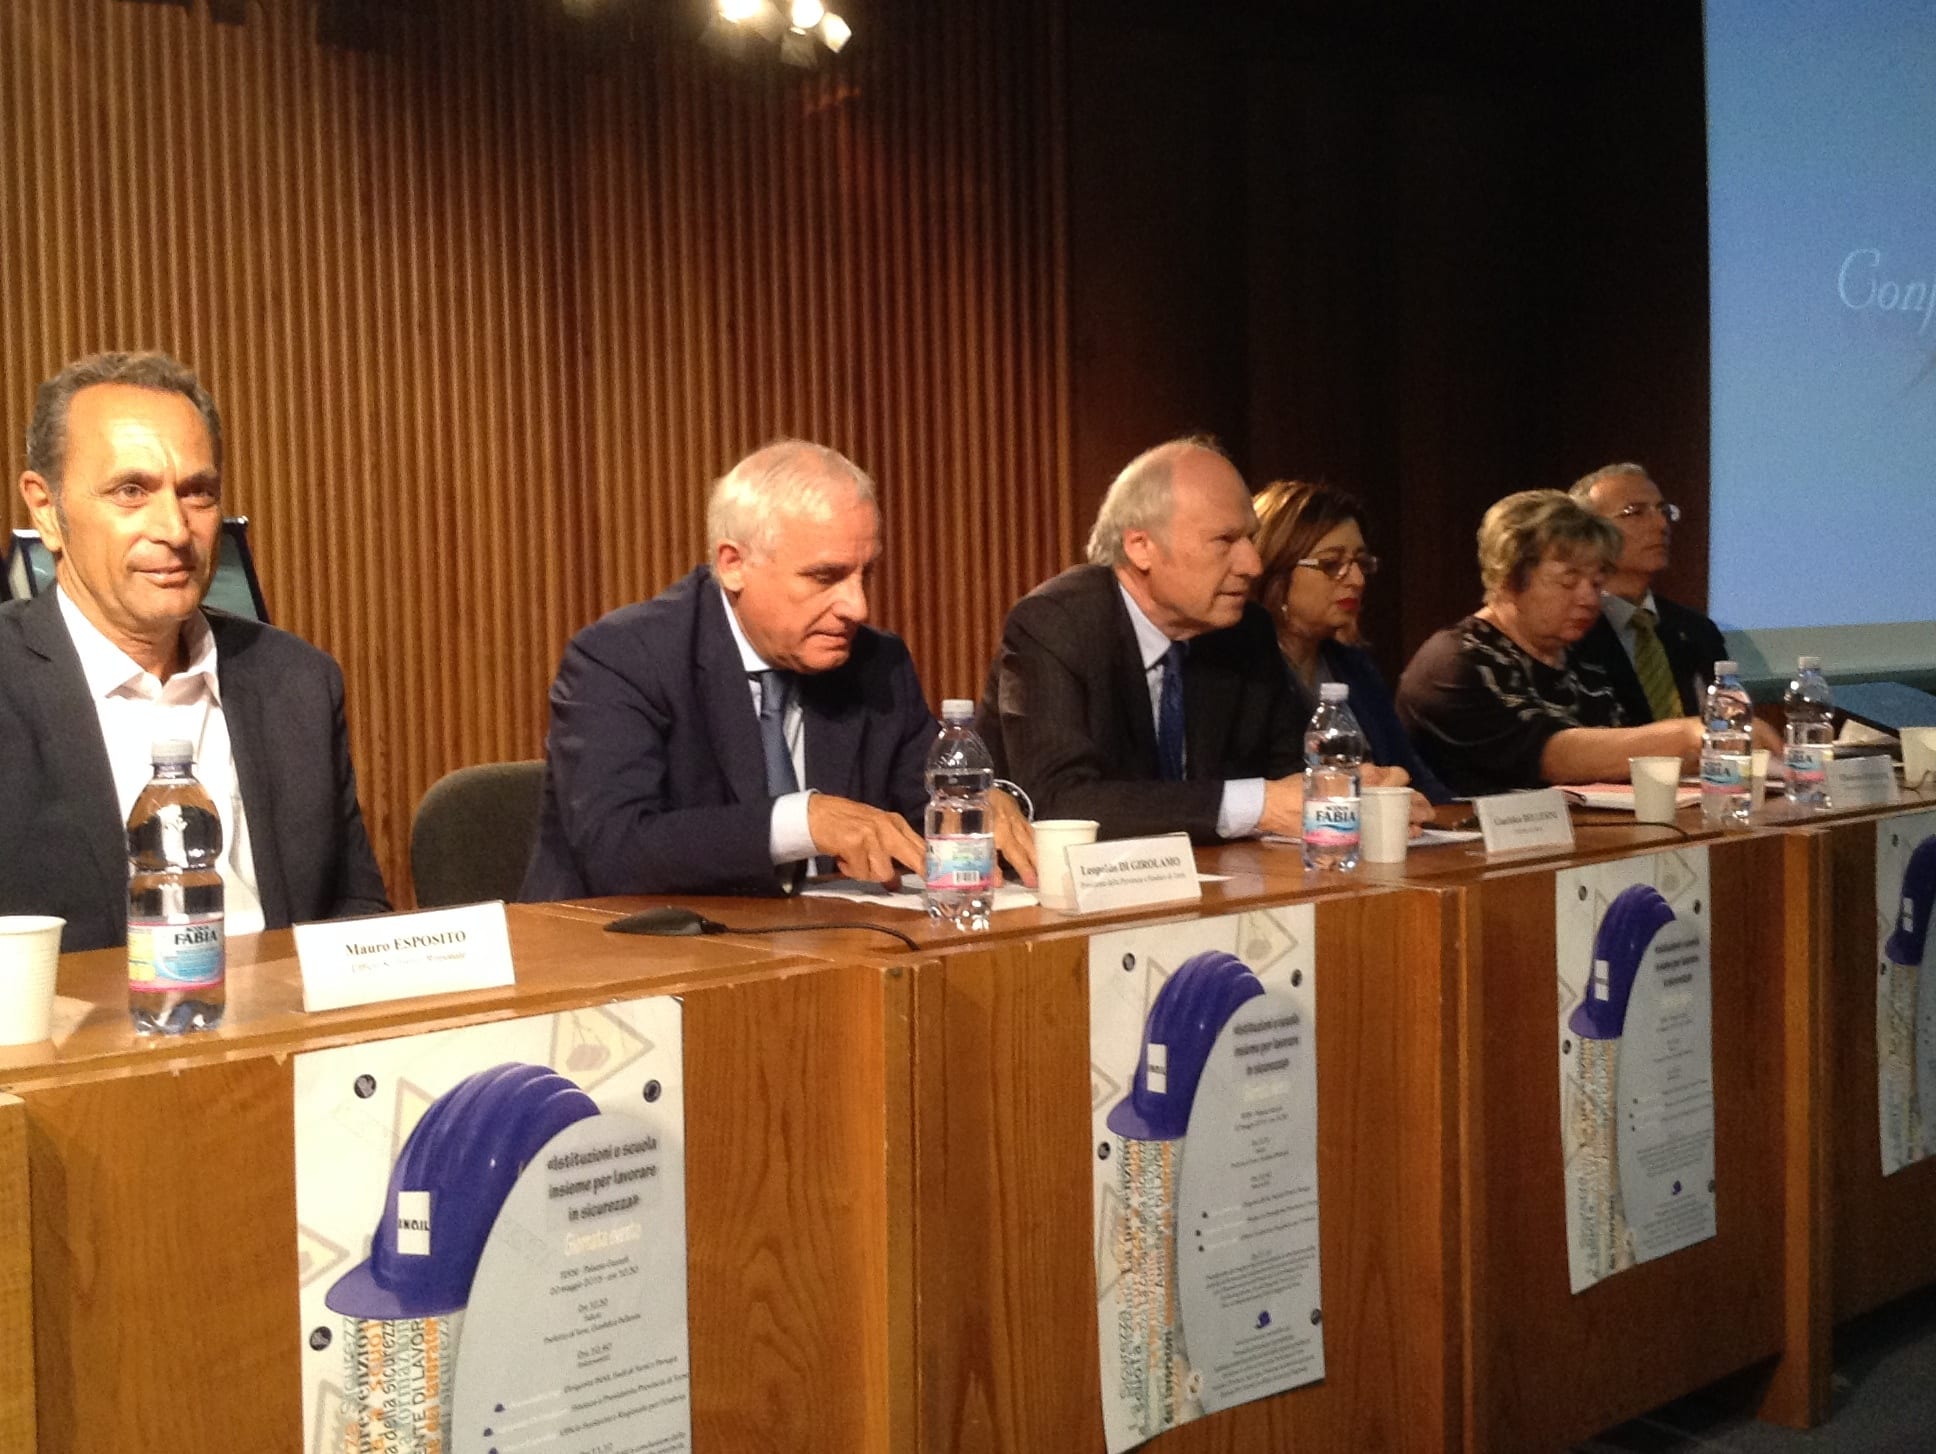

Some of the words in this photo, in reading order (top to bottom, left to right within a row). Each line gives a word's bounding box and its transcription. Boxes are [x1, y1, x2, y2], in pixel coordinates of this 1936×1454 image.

[1316, 810, 1356, 822] FABIA
[174, 929, 218, 945] FABIA
[345, 942, 391, 957] Mauro
[393, 930, 467, 951] ESPOSITO
[592, 1175, 613, 1195] per
[412, 1386, 425, 1406] DI
